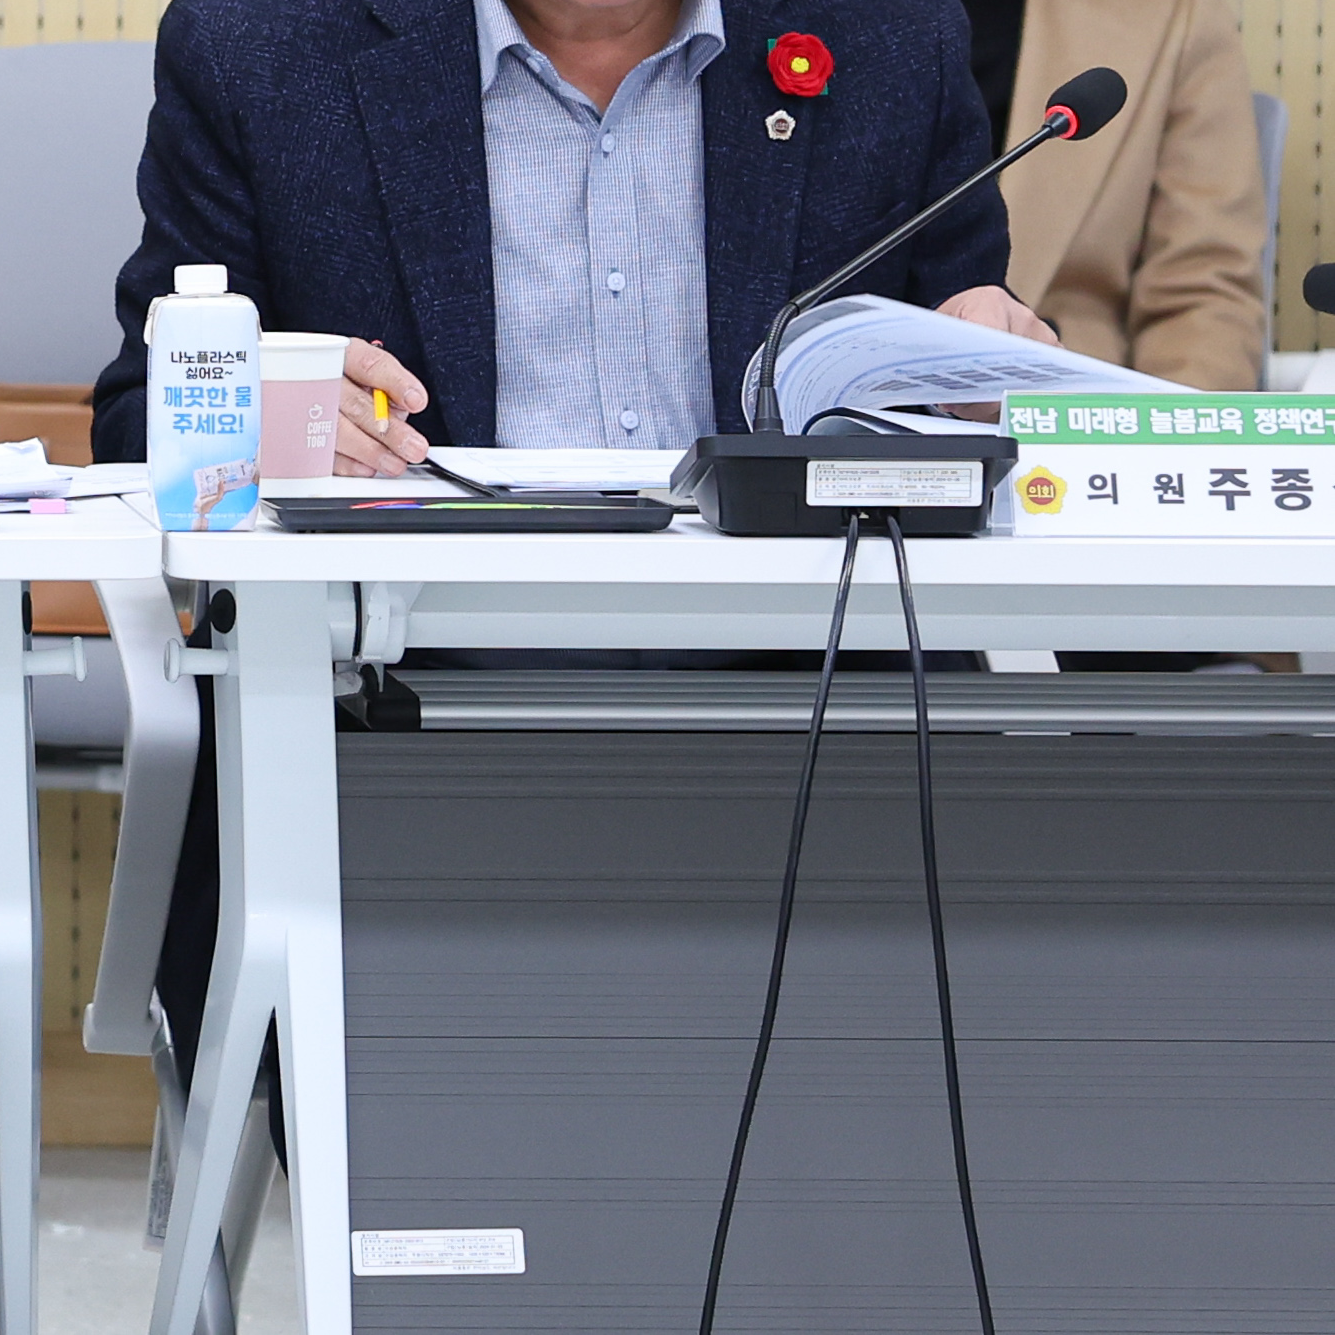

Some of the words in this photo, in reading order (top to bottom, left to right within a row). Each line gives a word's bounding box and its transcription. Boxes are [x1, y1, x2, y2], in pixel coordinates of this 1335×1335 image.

[170, 350, 247, 364] 나노플라스틱
[163, 385, 228, 408] 깨끗한
[234, 385, 252, 407] 물
[172, 413, 243, 435] 주세요!
[307, 420, 332, 435] COFFEE
[1009, 407, 1059, 435] 전남
[1067, 407, 1139, 435] 미래형
[1149, 407, 1244, 435] 늘봄교육
[1028, 485, 1055, 499] 의회
[1208, 468, 1335, 512] 주종
